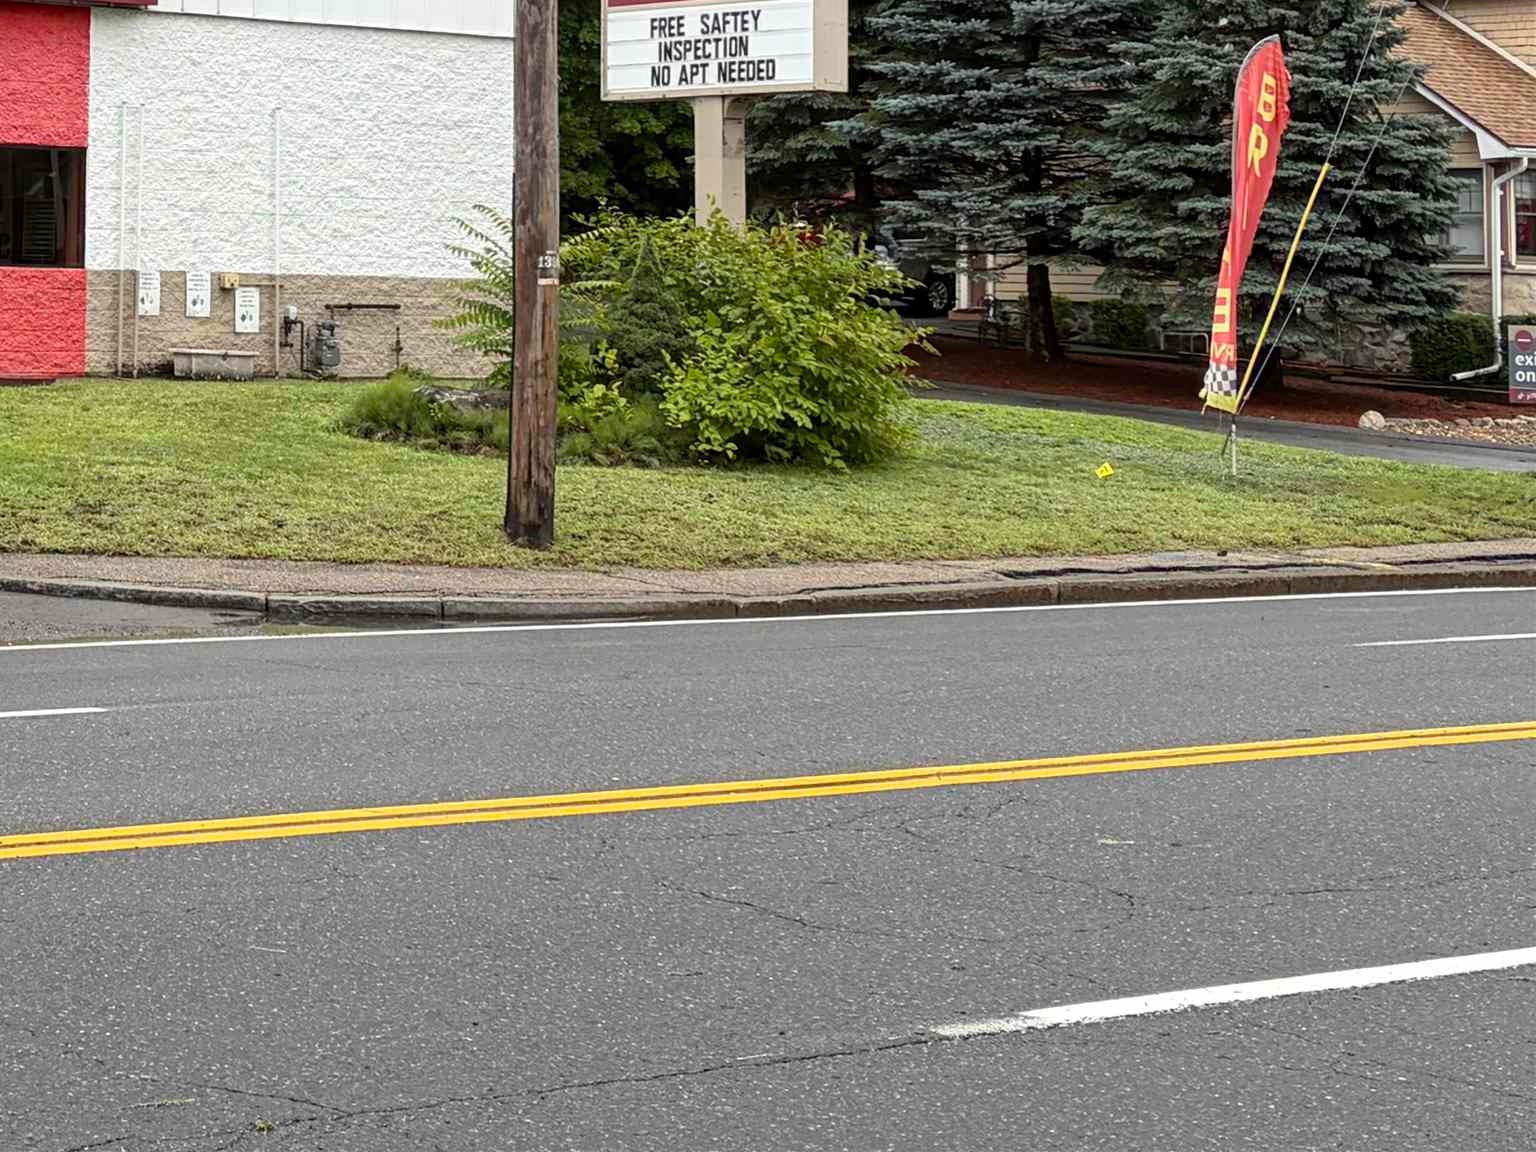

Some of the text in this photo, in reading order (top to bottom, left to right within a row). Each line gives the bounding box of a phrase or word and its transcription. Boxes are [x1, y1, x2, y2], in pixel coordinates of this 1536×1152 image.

[650, 9, 762, 39] FREE SAFTEY
[658, 35, 749, 63] INSPECTION
[651, 58, 776, 88] NO APT NEEDED
